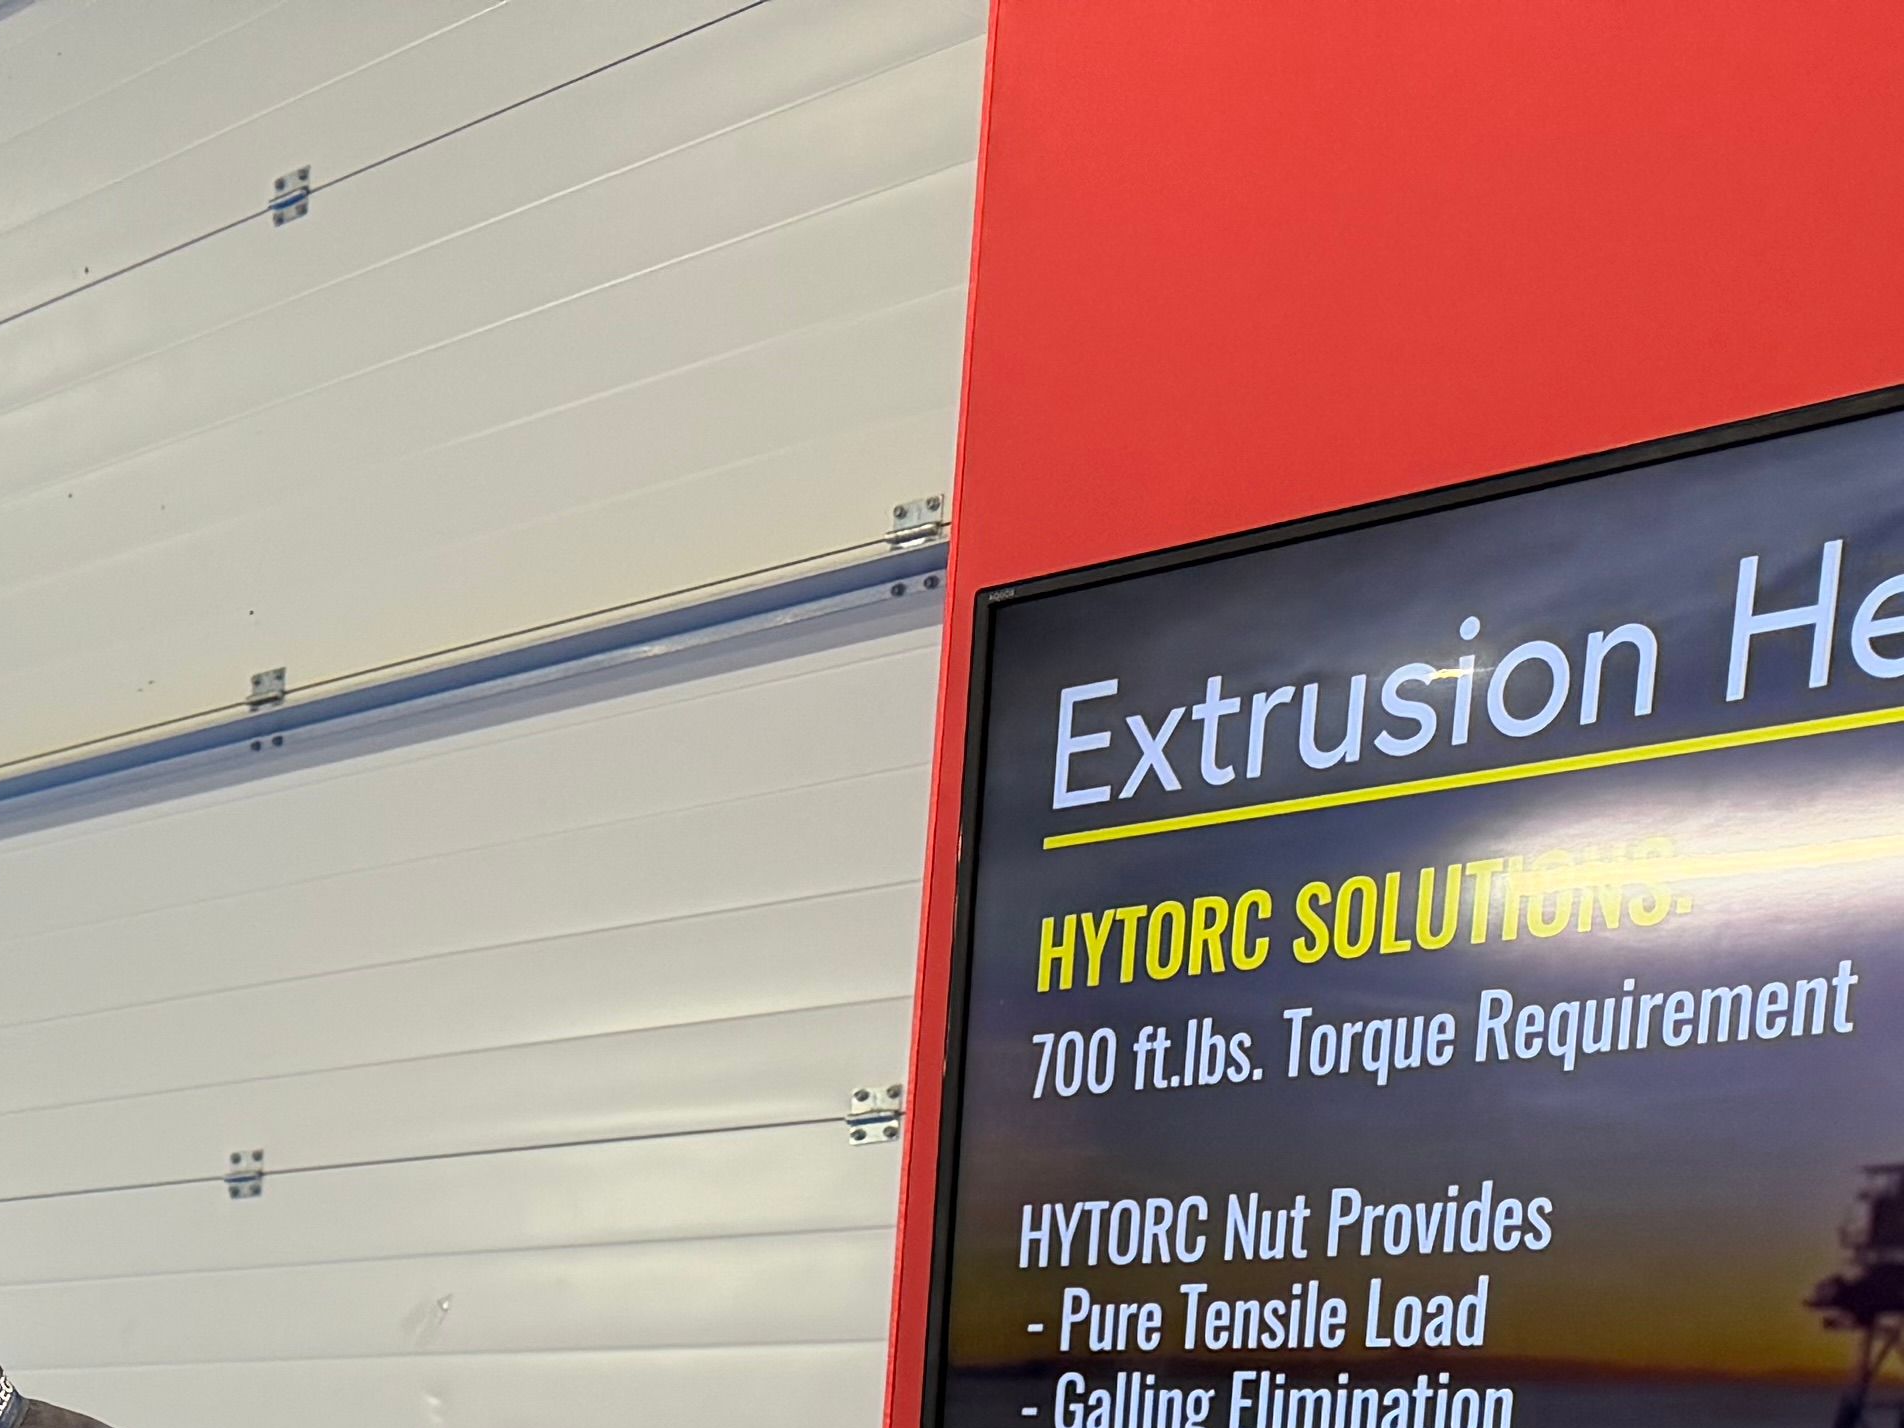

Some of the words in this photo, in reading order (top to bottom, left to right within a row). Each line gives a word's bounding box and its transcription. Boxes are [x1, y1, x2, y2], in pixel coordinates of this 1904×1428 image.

[1051, 613, 1659, 811] Extrusion
[1035, 888, 1271, 994] HYTORC
[1030, 1026, 1116, 1100] 700
[1132, 1017, 1265, 1092] ft.lbs.
[1282, 1006, 1456, 1090] Torque
[1475, 959, 1859, 1073] Requirement
[1017, 1194, 1208, 1269] HYTORC
[1222, 1191, 1311, 1262] Nut
[1325, 1180, 1554, 1259] Provides
[1058, 1286, 1162, 1352] Pure
[1179, 1279, 1348, 1351] Tensile
[1364, 1274, 1490, 1349] Load
